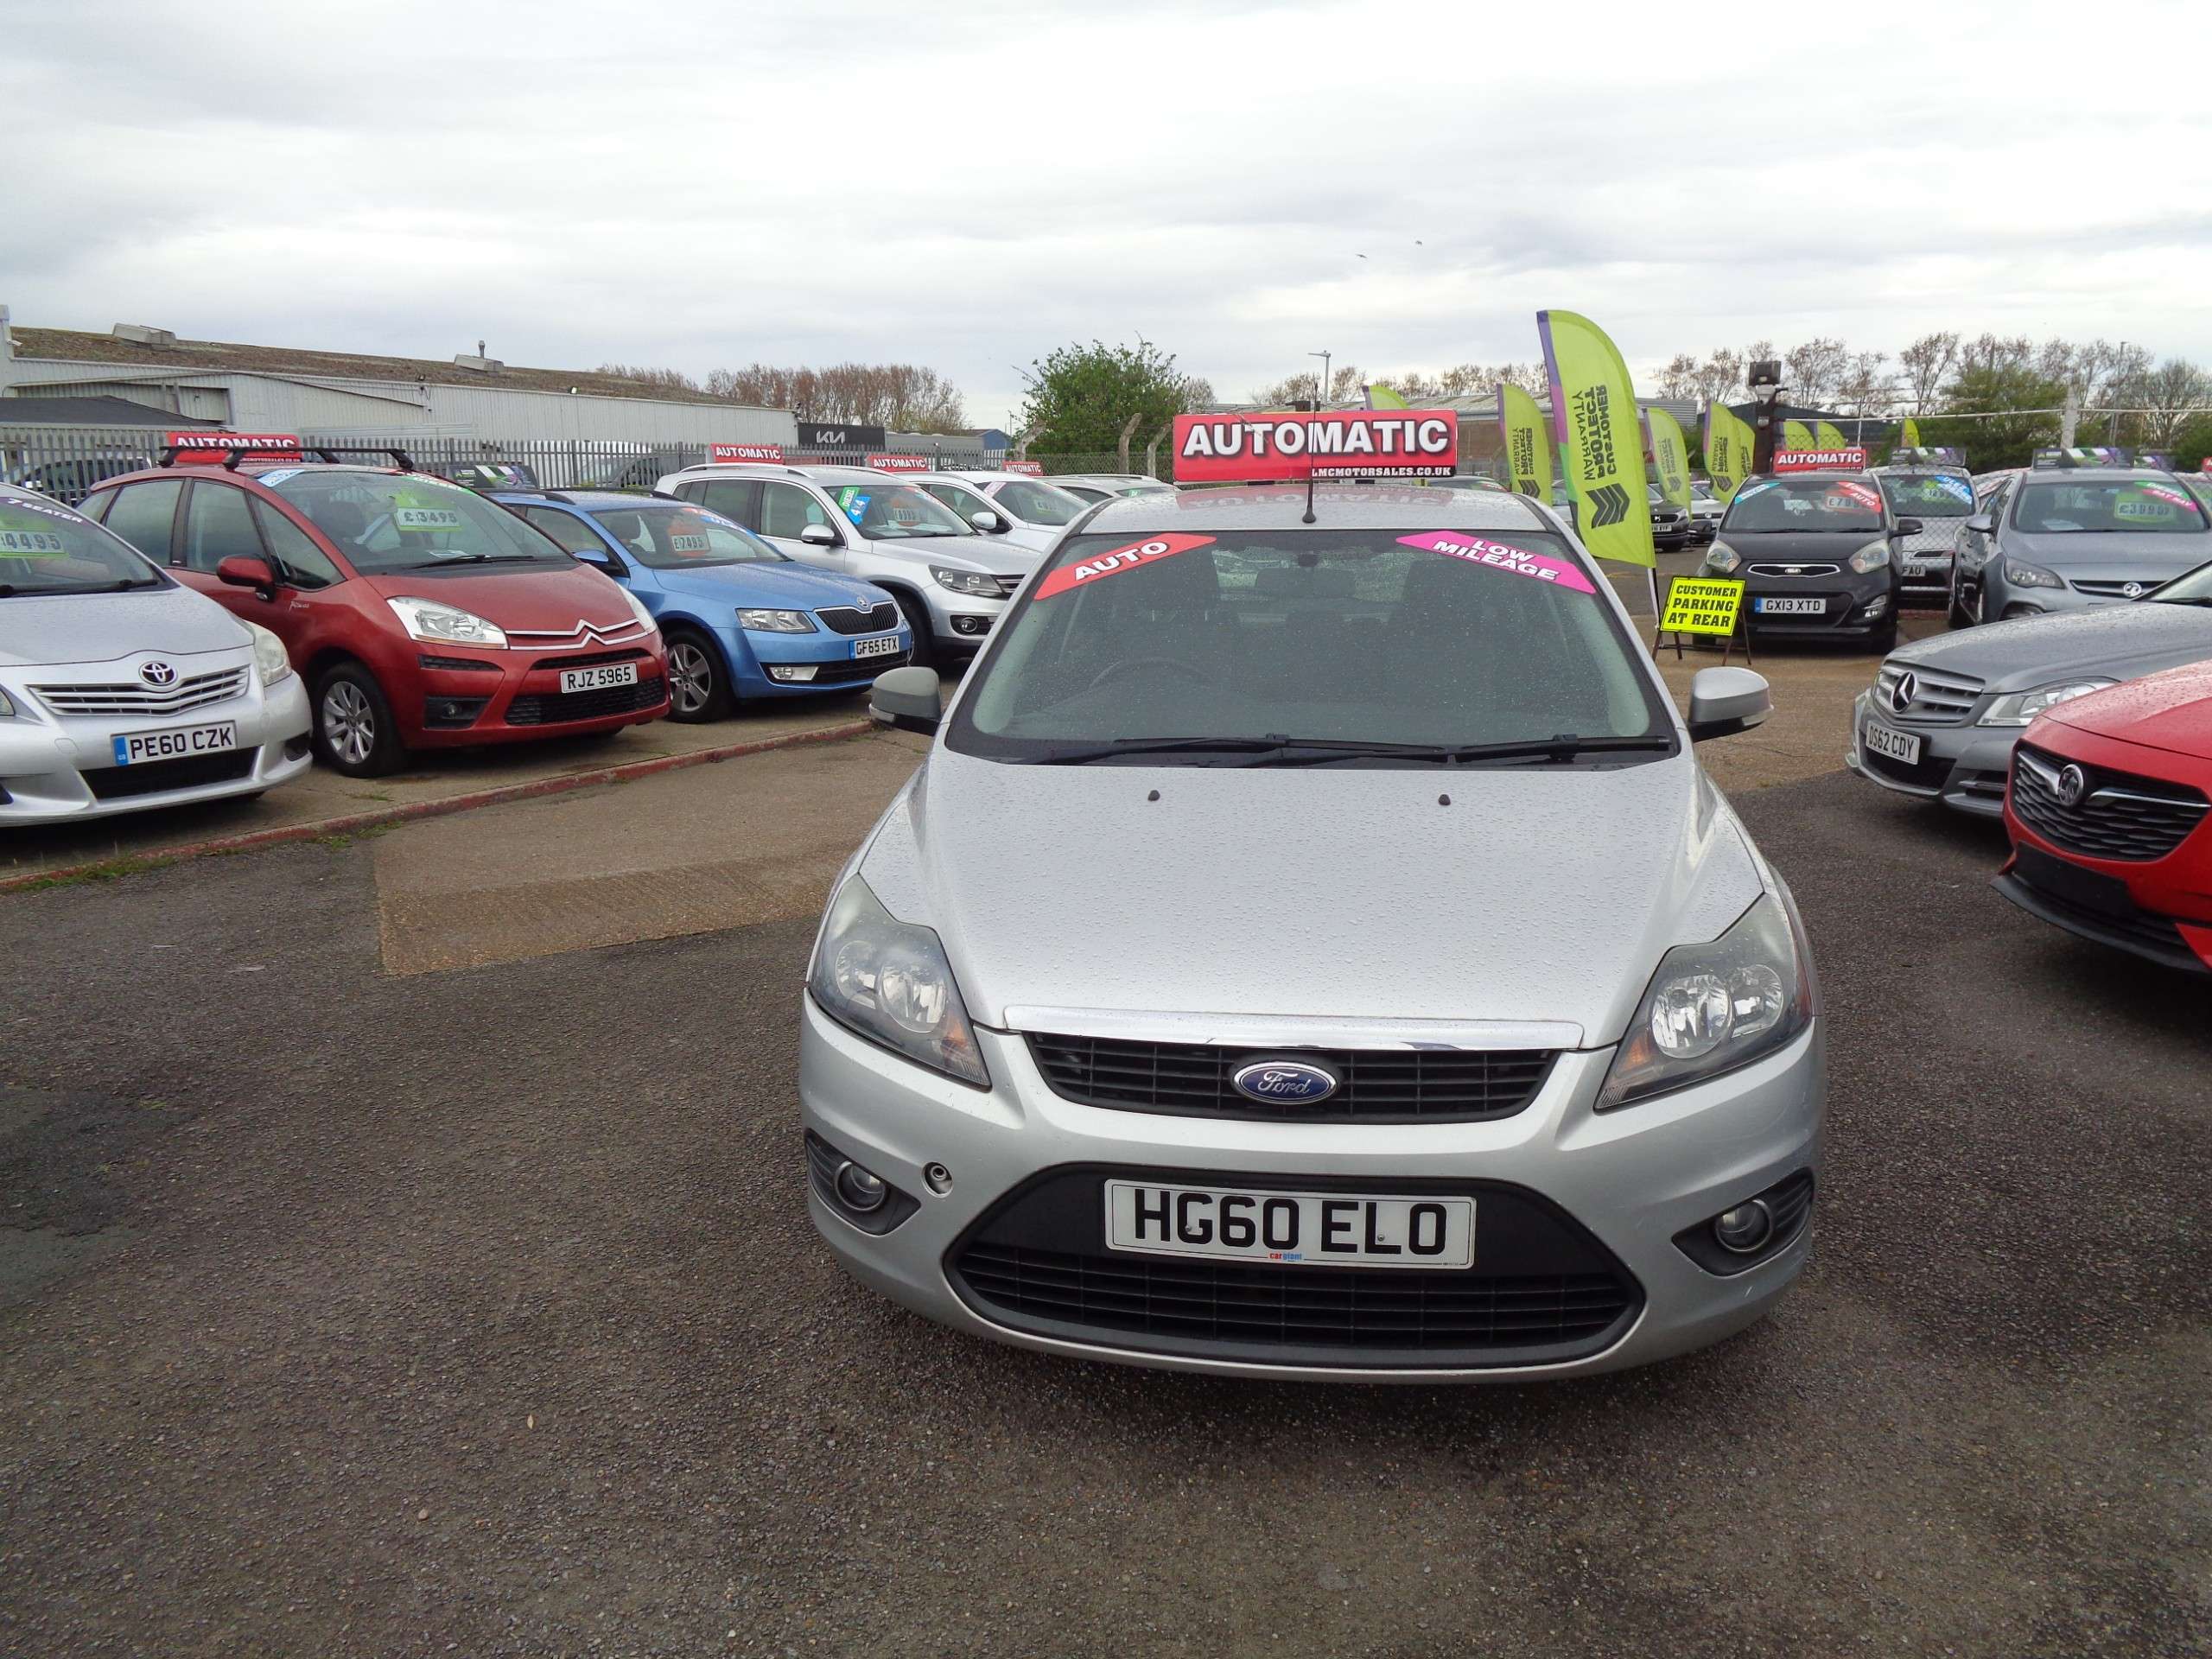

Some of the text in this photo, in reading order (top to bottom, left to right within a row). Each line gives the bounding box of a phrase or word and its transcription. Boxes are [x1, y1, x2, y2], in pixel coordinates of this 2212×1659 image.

[1182, 419, 1449, 457] AUTOMATIC
[715, 446, 781, 460] AUTOMATIC
[873, 456, 926, 468] AUTOMATIC
[1777, 452, 1863, 464] AUTOMATIC
[1006, 463, 1042, 474] AUTOMATIC
[1312, 467, 1452, 477] LMCMOTORSALES.CO.UK
[22, 502, 83, 524] SEATER
[1074, 541, 1169, 582] AUTO
[1432, 540, 1560, 581] MILEAGE
[1471, 540, 1535, 563] LOW
[1676, 585, 1738, 597] CUSTOMER
[1673, 598, 1734, 612] PARKING
[1766, 600, 1821, 611] GX13 XTD
[1668, 612, 1731, 627] AT REAR
[856, 637, 898, 655] GF65 ETX
[567, 666, 632, 690] RJZ 5965
[130, 733, 187, 760] PE60
[192, 727, 233, 750] CZK
[1869, 725, 1914, 759] DS62 CDY
[1257, 1071, 1312, 1094] Ford
[1135, 1188, 1447, 1255] HG60 ELO
